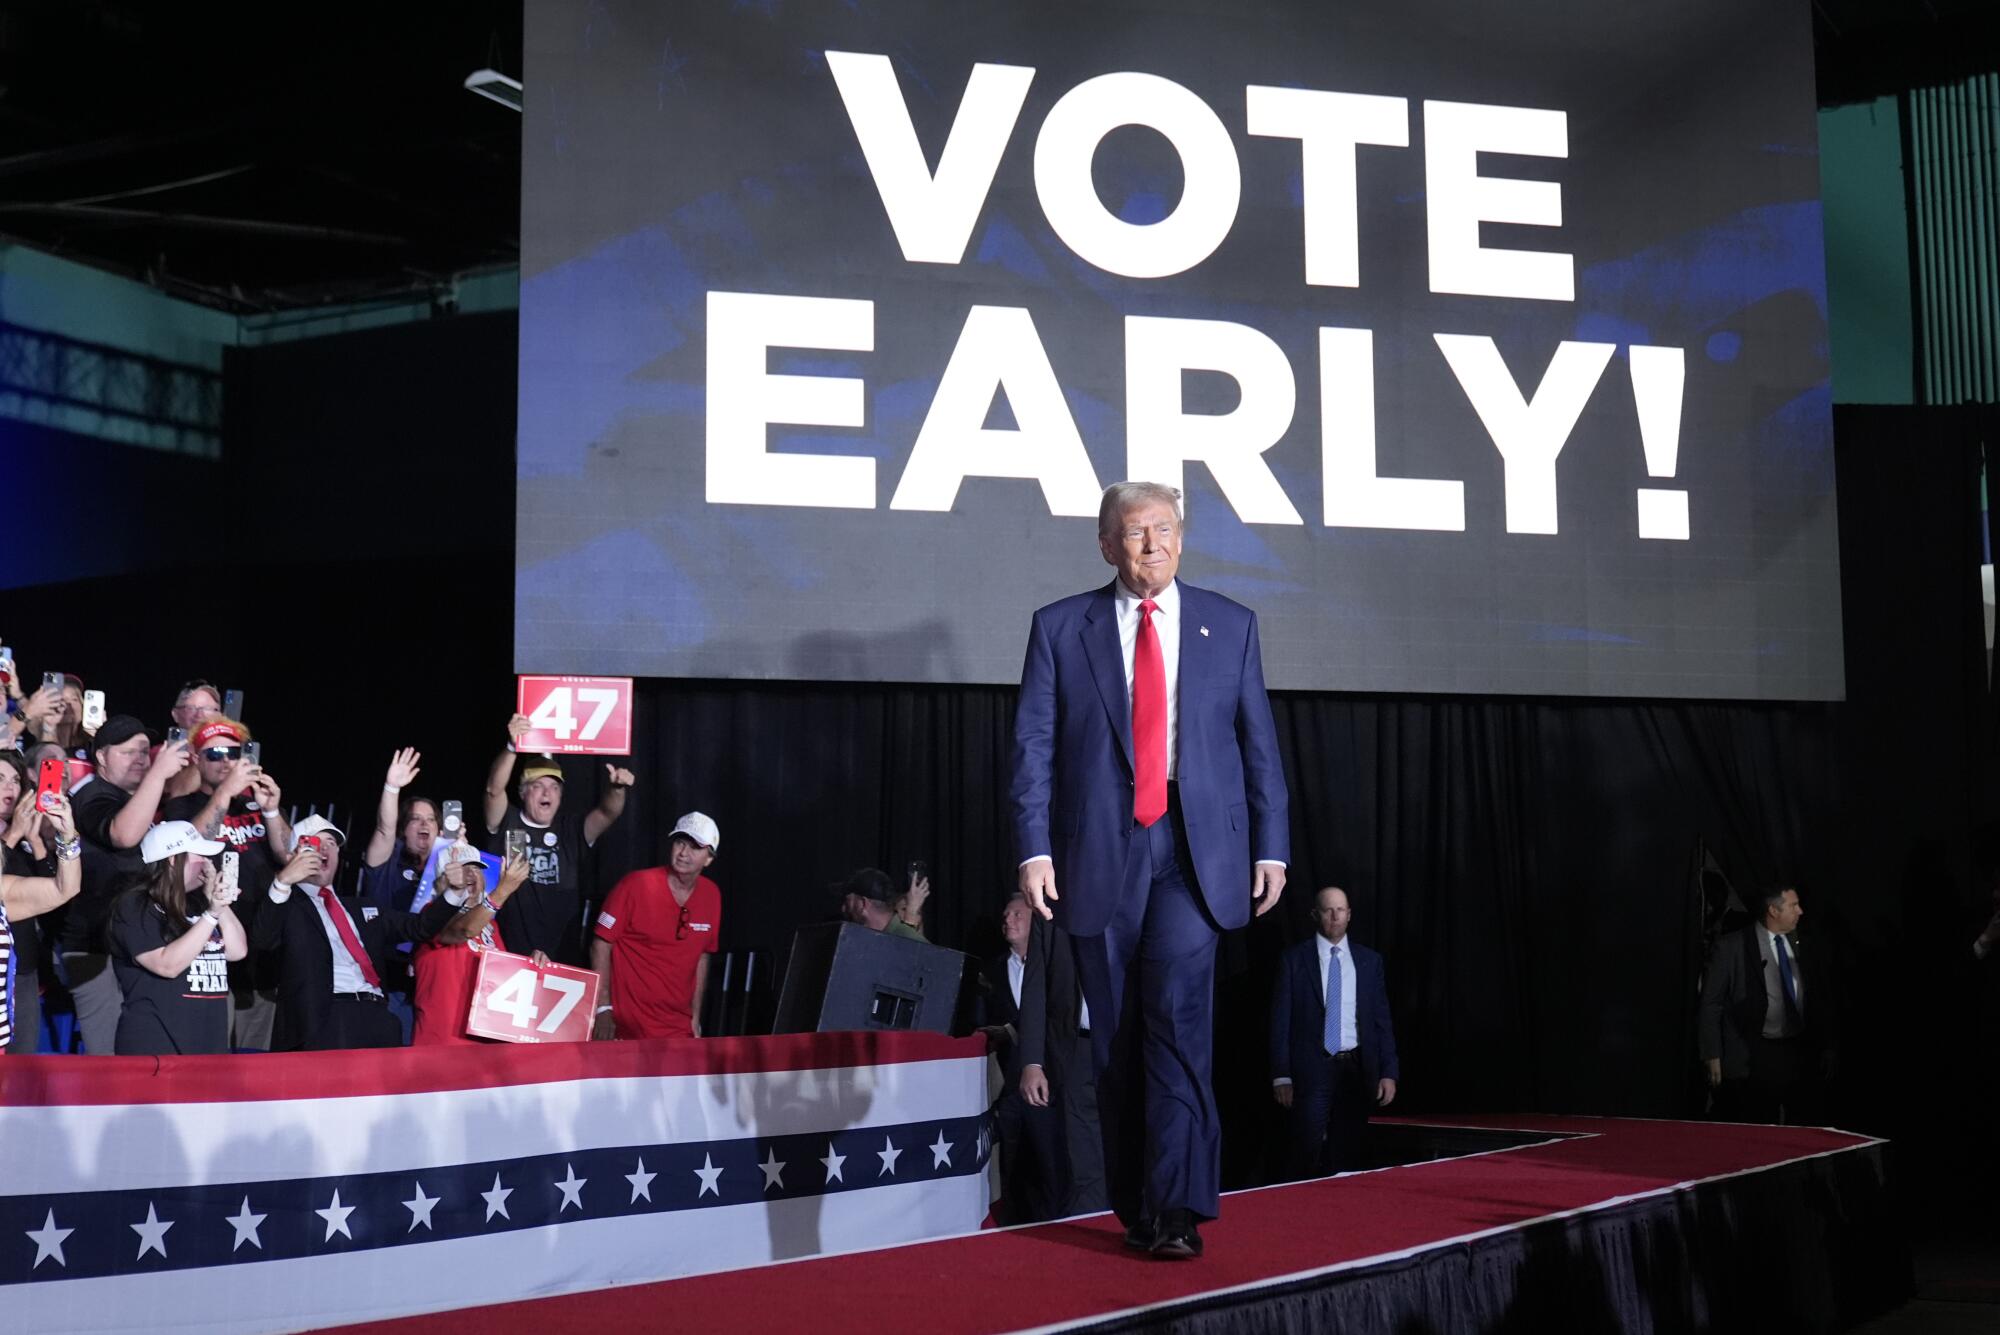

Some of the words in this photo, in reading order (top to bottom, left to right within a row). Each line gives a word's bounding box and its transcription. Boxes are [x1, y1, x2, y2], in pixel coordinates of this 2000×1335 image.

[825, 50, 1575, 302] VOTE
[705, 291, 1690, 540] EARLY!
[529, 688, 619, 740] 47
[487, 969, 586, 1033] 47
